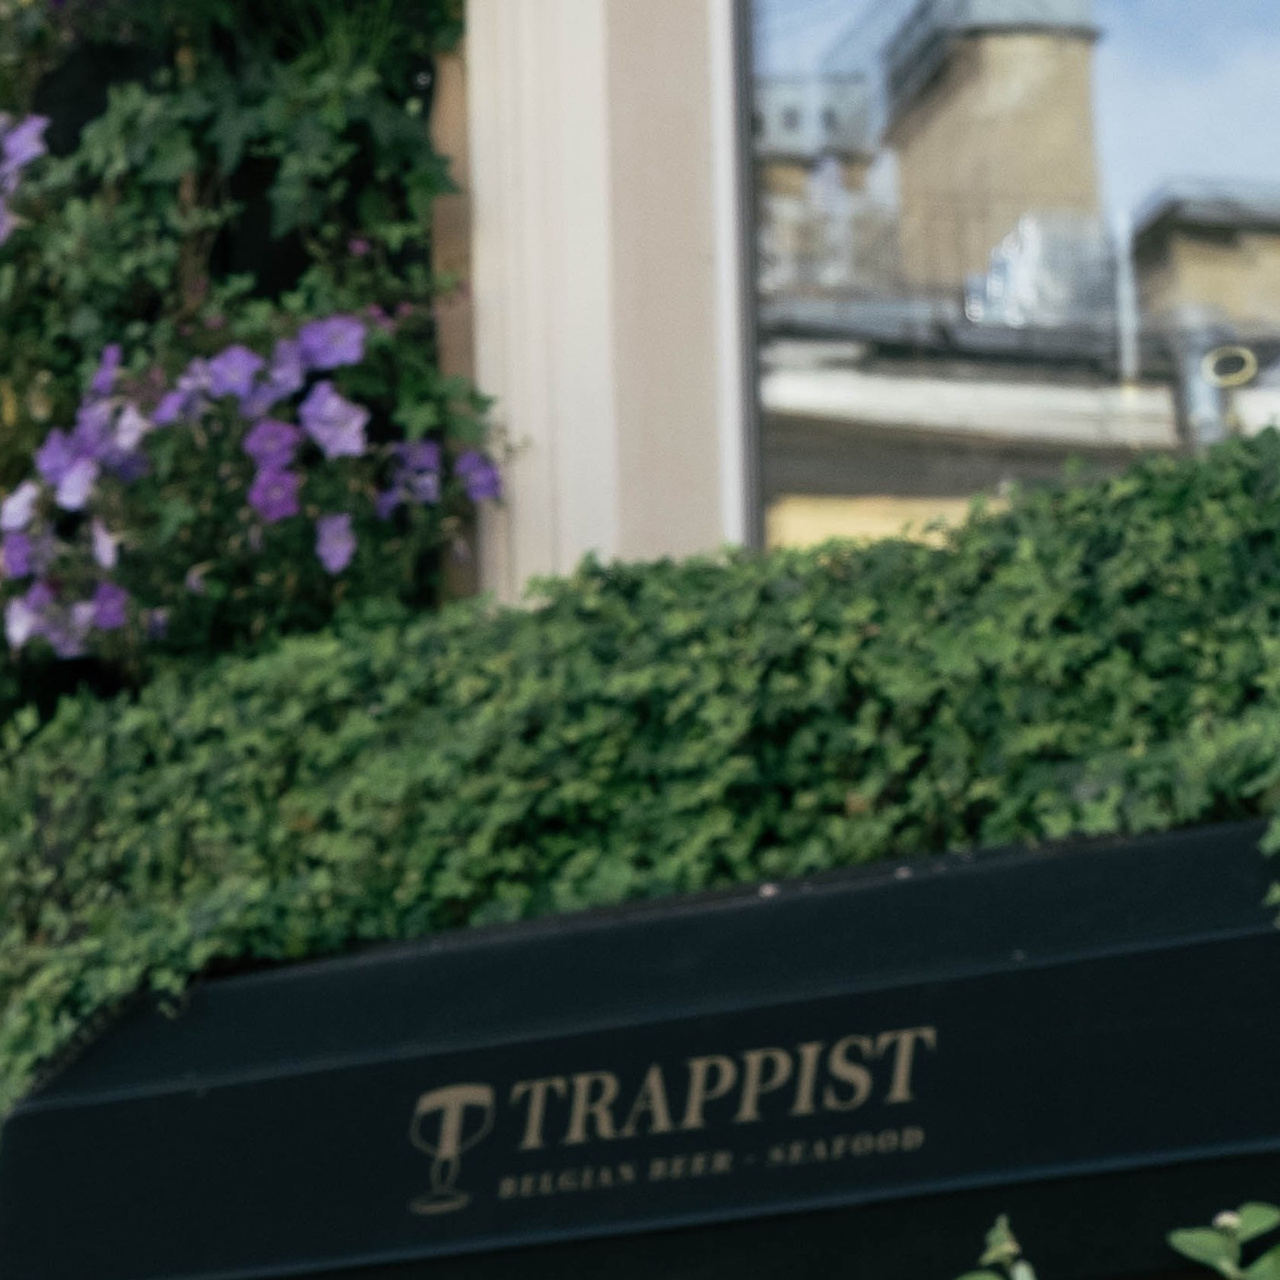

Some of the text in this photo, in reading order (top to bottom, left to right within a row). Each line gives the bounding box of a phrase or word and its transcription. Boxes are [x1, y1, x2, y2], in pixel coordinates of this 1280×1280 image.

[510, 1026, 936, 1150] TRAPPIST
[498, 1125, 926, 1198] BELGIAN BEER SEAFOOD
